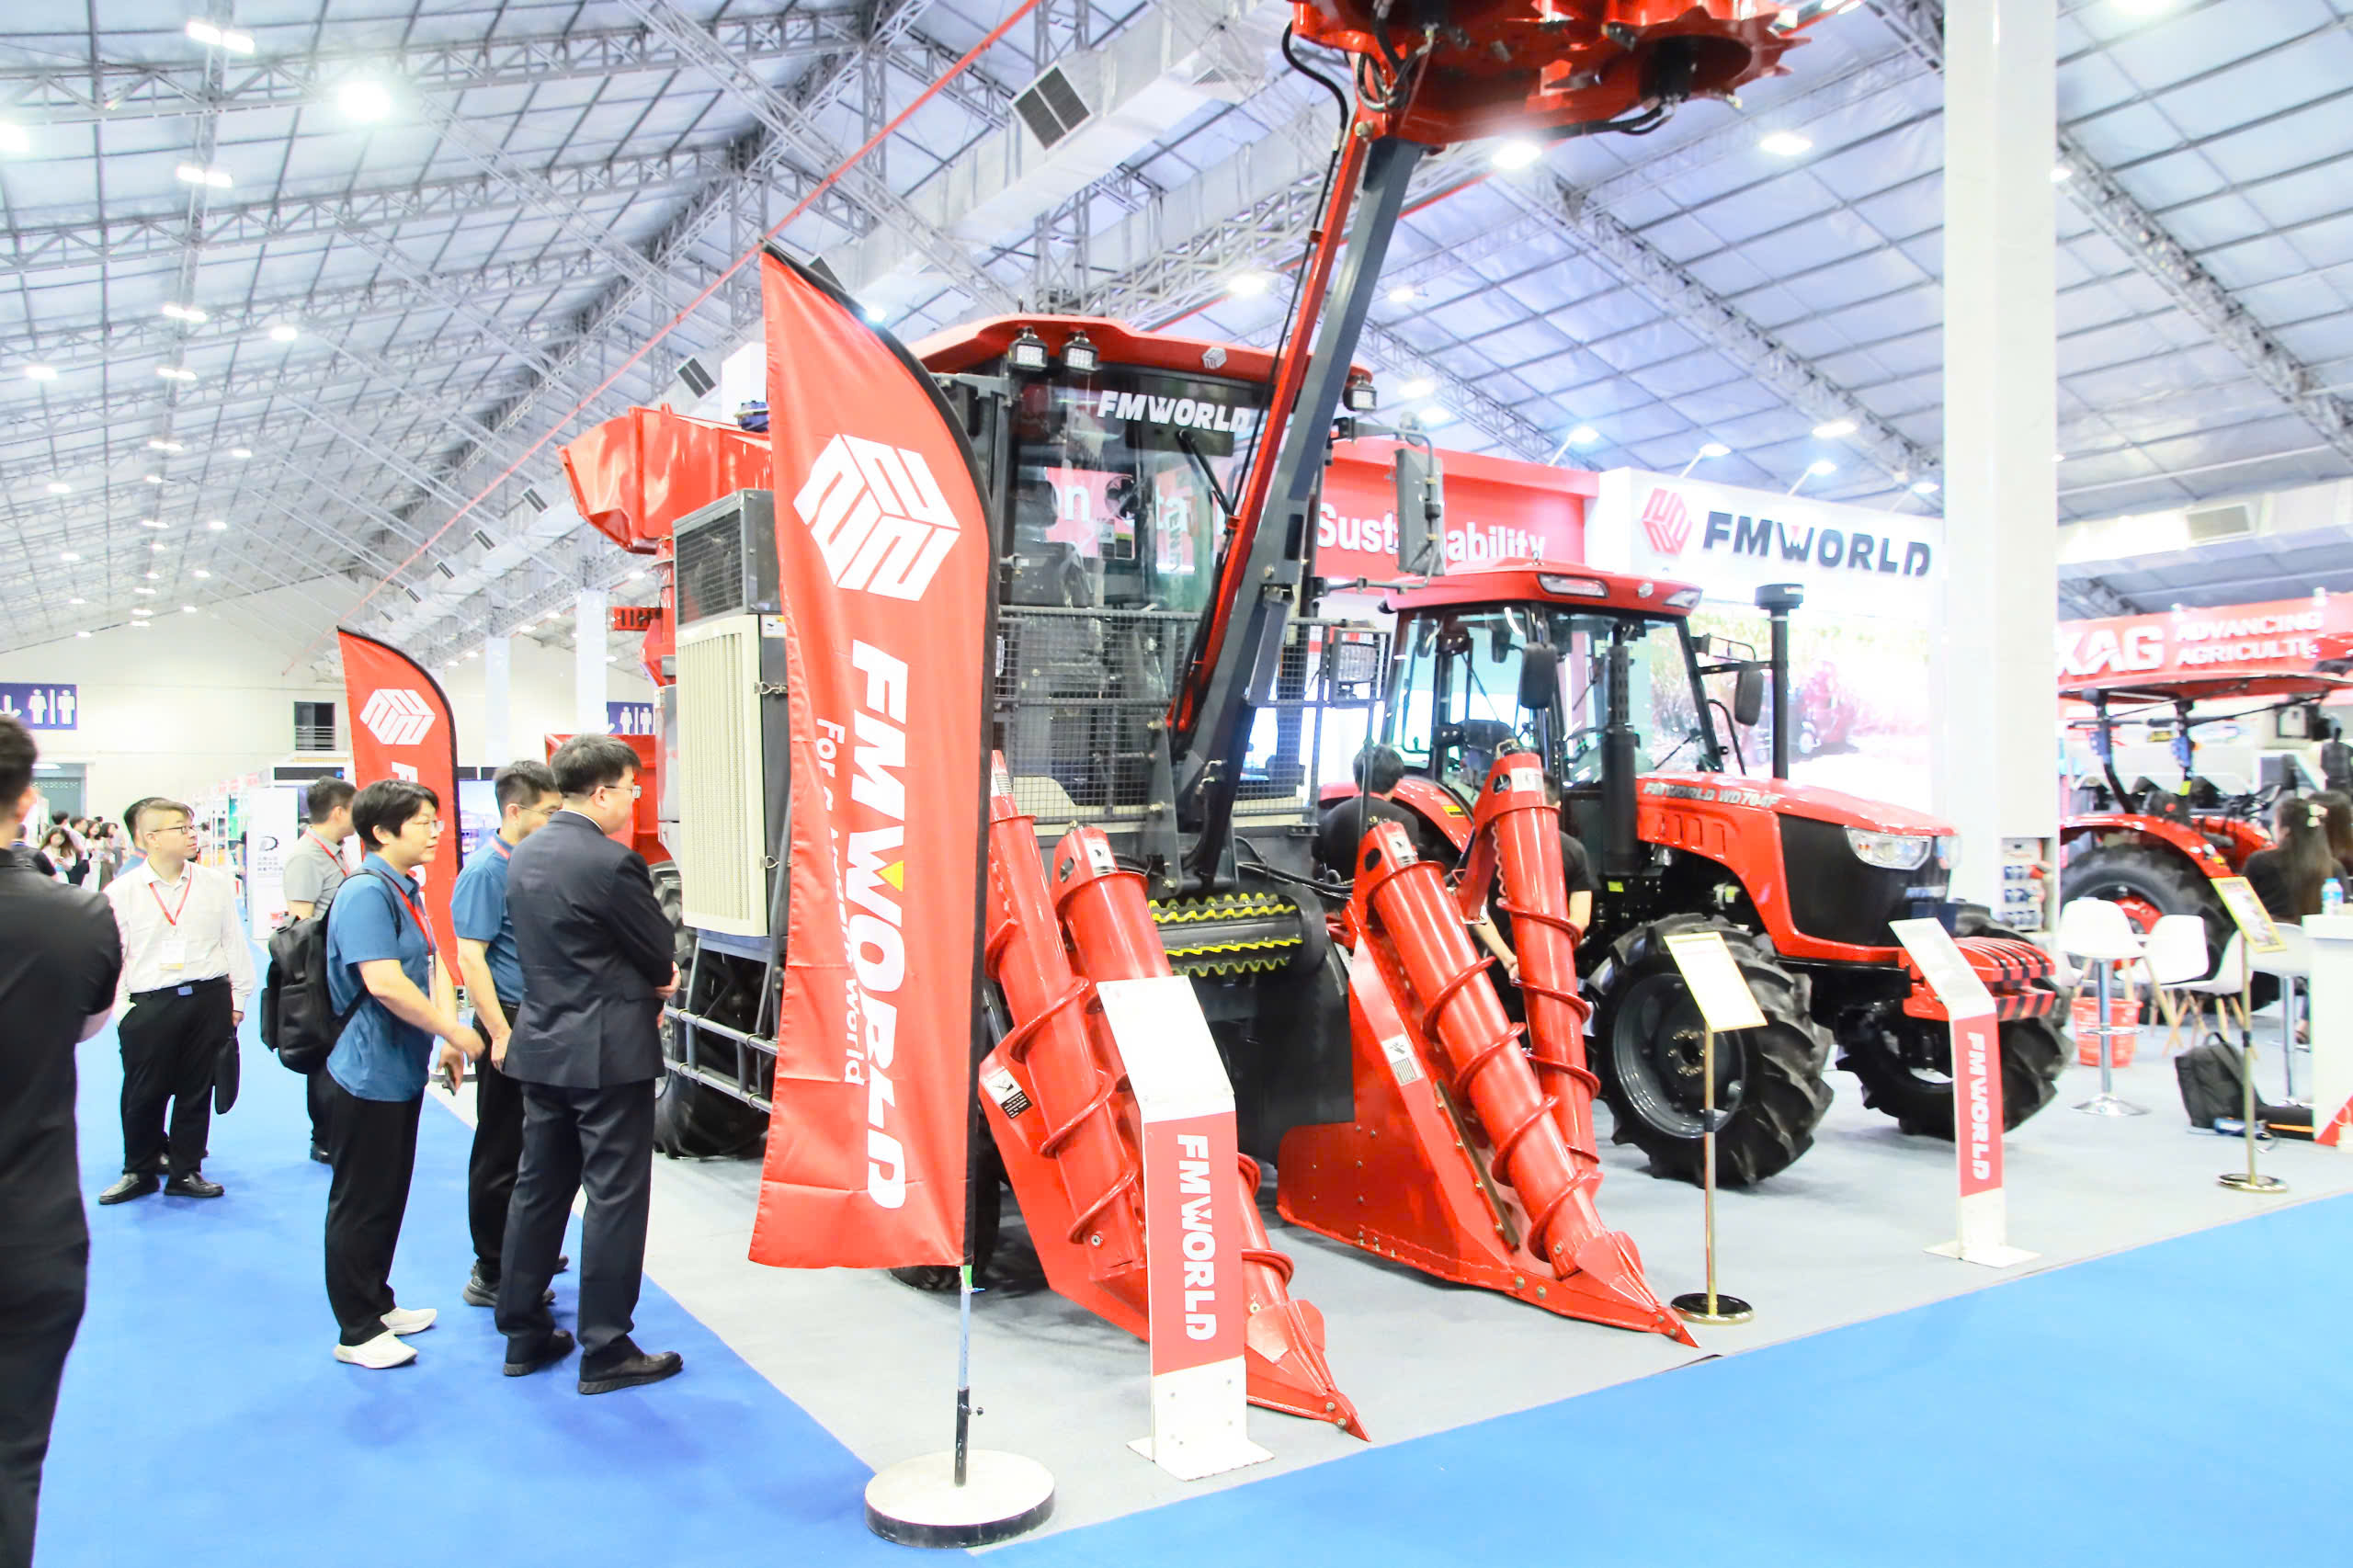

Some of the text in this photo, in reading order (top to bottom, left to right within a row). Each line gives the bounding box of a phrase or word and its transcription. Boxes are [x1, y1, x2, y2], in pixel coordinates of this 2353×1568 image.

[1097, 390, 1251, 434] FMWORLD
[1317, 502, 1546, 562] Sustability
[1702, 510, 1932, 577] FMWORLD
[2175, 611, 2325, 642] ADVANCING
[1643, 781, 1716, 801] FMWORLD
[846, 639, 909, 1209] FMWORLD
[1967, 1031, 1991, 1180] FMWORLD
[1176, 1134, 1218, 1341] FMWORLD
